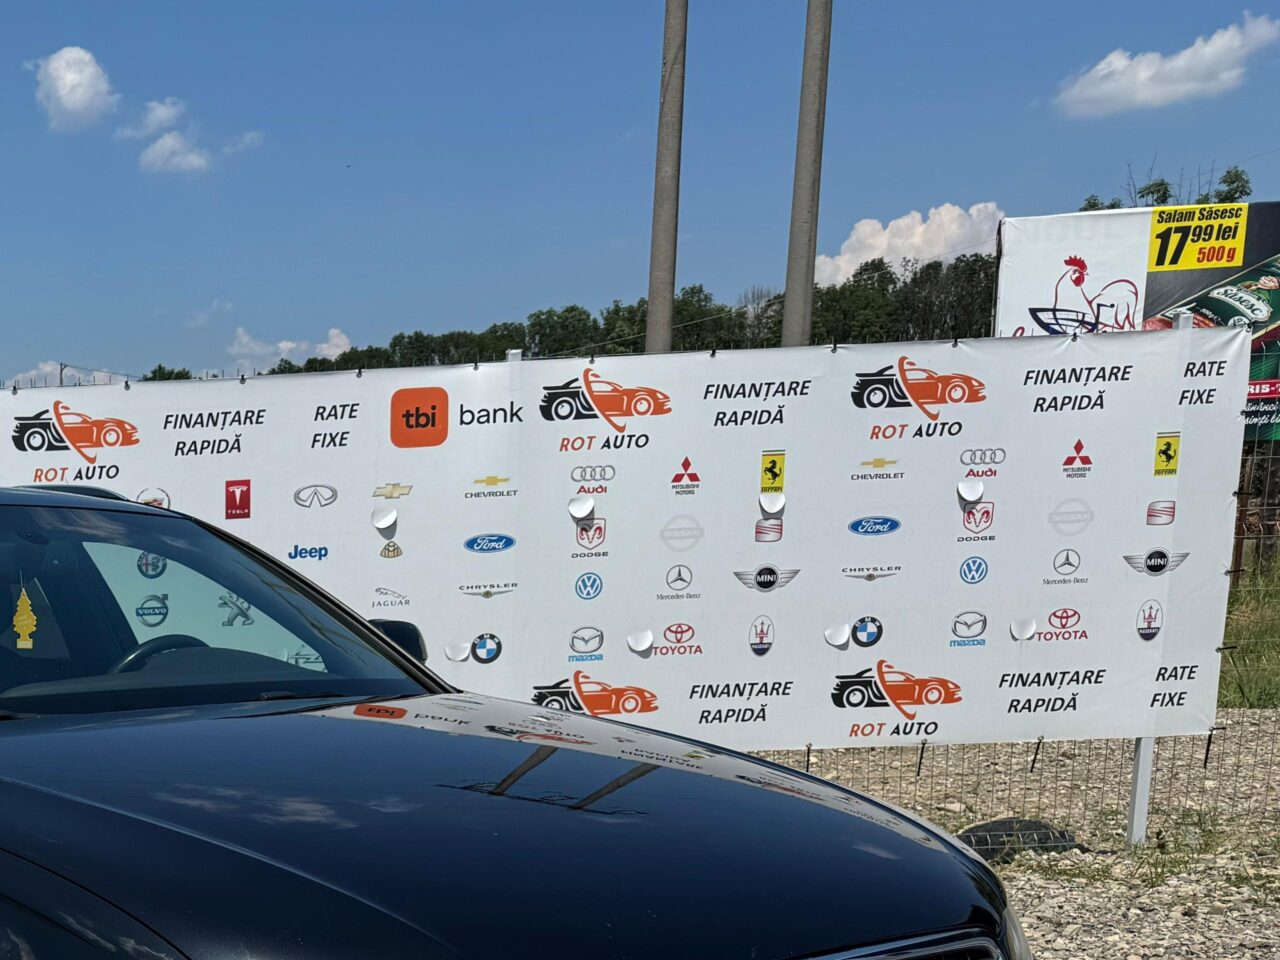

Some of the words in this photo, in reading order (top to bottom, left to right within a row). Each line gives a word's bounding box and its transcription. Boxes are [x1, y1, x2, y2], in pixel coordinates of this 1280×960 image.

[1157, 209, 1195, 224] Salam
[1198, 206, 1242, 221] Săsesc
[1155, 225, 1192, 266] 17
[1190, 224, 1214, 243] 99
[1216, 222, 1239, 241] lei
[1196, 245, 1225, 263] 500
[1226, 247, 1236, 262] g
[1023, 365, 1134, 387] FINANȚARE
[1183, 360, 1227, 377] RATE
[703, 380, 812, 402] FINANȚARE
[1178, 389, 1217, 405] FIXE
[1033, 390, 1105, 413] RAPIDĂ
[162, 409, 267, 431] FINANȚARE
[314, 403, 360, 421] RATE
[402, 405, 437, 430] tbi
[459, 401, 524, 426] bank
[713, 405, 784, 427] RAPIDĂ
[870, 424, 908, 441] ROT
[912, 421, 963, 439] AUTO
[174, 433, 242, 457] RAPIDĂ
[311, 431, 350, 449] FIXE
[559, 436, 596, 452] ROT
[601, 434, 649, 450] AUTO
[33, 467, 69, 483] ROT
[73, 465, 120, 481] AUTO
[850, 472, 905, 480] CHEVROLET
[965, 468, 997, 478] Audi
[464, 489, 518, 499] CHEVROLET
[577, 485, 607, 494] Audi
[858, 518, 891, 533] Ford
[473, 535, 506, 550] Ford
[288, 544, 328, 561] Jeep
[571, 551, 608, 559] DODGE
[1146, 558, 1166, 566] MINI
[458, 582, 518, 591] CHRYSLER
[756, 574, 776, 582] MINI
[1042, 577, 1088, 585] Mercedes-Benz
[371, 599, 410, 608] JAGUAR
[656, 592, 701, 600] Mercedes-Benz
[854, 616, 881, 628] BMW
[949, 639, 986, 648] mazda
[1036, 630, 1088, 642] TOYOTA
[568, 653, 603, 662] mazda
[652, 645, 703, 656] TOYOTA
[998, 669, 1107, 690] FINANȚARE
[1155, 665, 1199, 682] RATE
[689, 681, 793, 700] FINANȚARE
[1007, 693, 1079, 713] RAPIDĂ
[1150, 691, 1187, 708] FIXE
[698, 704, 768, 724] RAPIDĂ
[849, 723, 886, 738] ROT
[890, 721, 938, 736] AUTO
